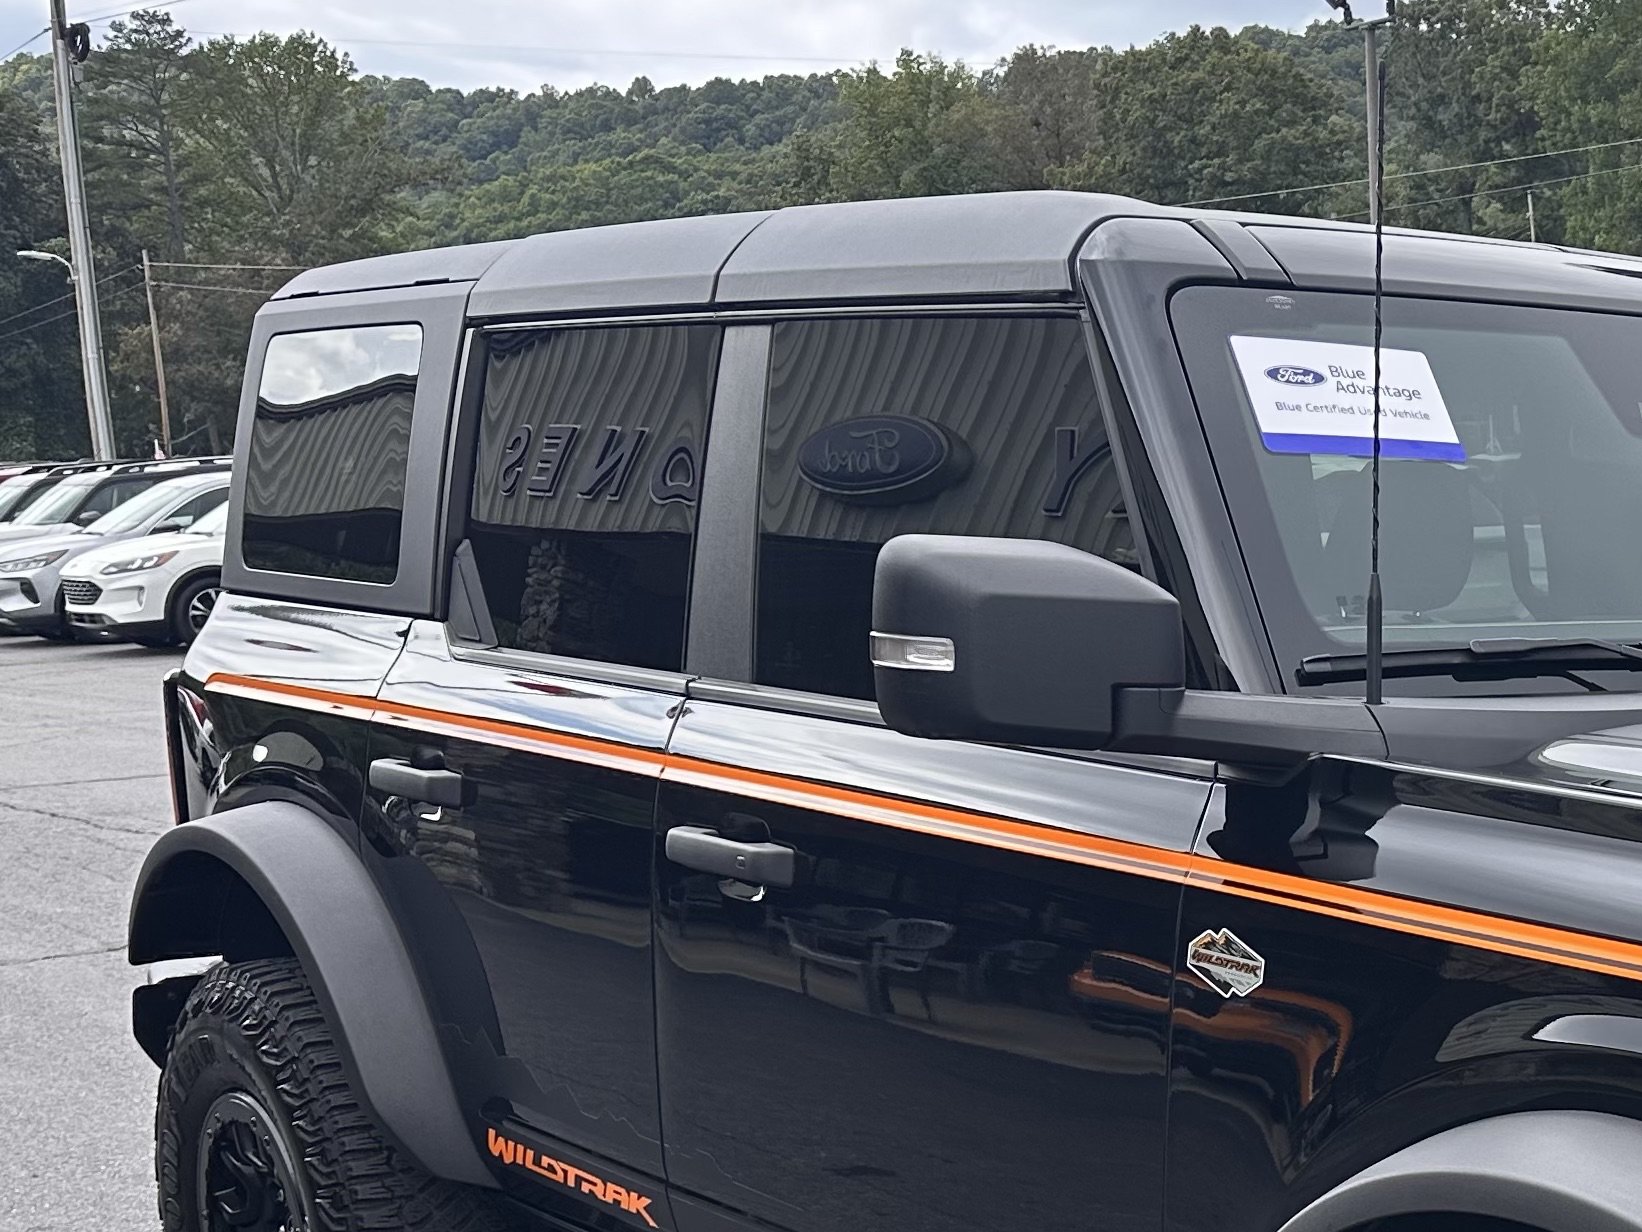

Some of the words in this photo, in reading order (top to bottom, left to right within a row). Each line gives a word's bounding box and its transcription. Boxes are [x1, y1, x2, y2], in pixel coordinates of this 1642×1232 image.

[1277, 367, 1316, 385] Ford
[1328, 365, 1366, 379] Blue
[1275, 401, 1302, 412] Blue
[1305, 402, 1355, 415] Certified
[1358, 406, 1387, 417] Usd
[1389, 408, 1431, 421] Vehicle
[1191, 948, 1262, 979] WILDTRAK
[487, 1127, 660, 1229] WILDTRAK
